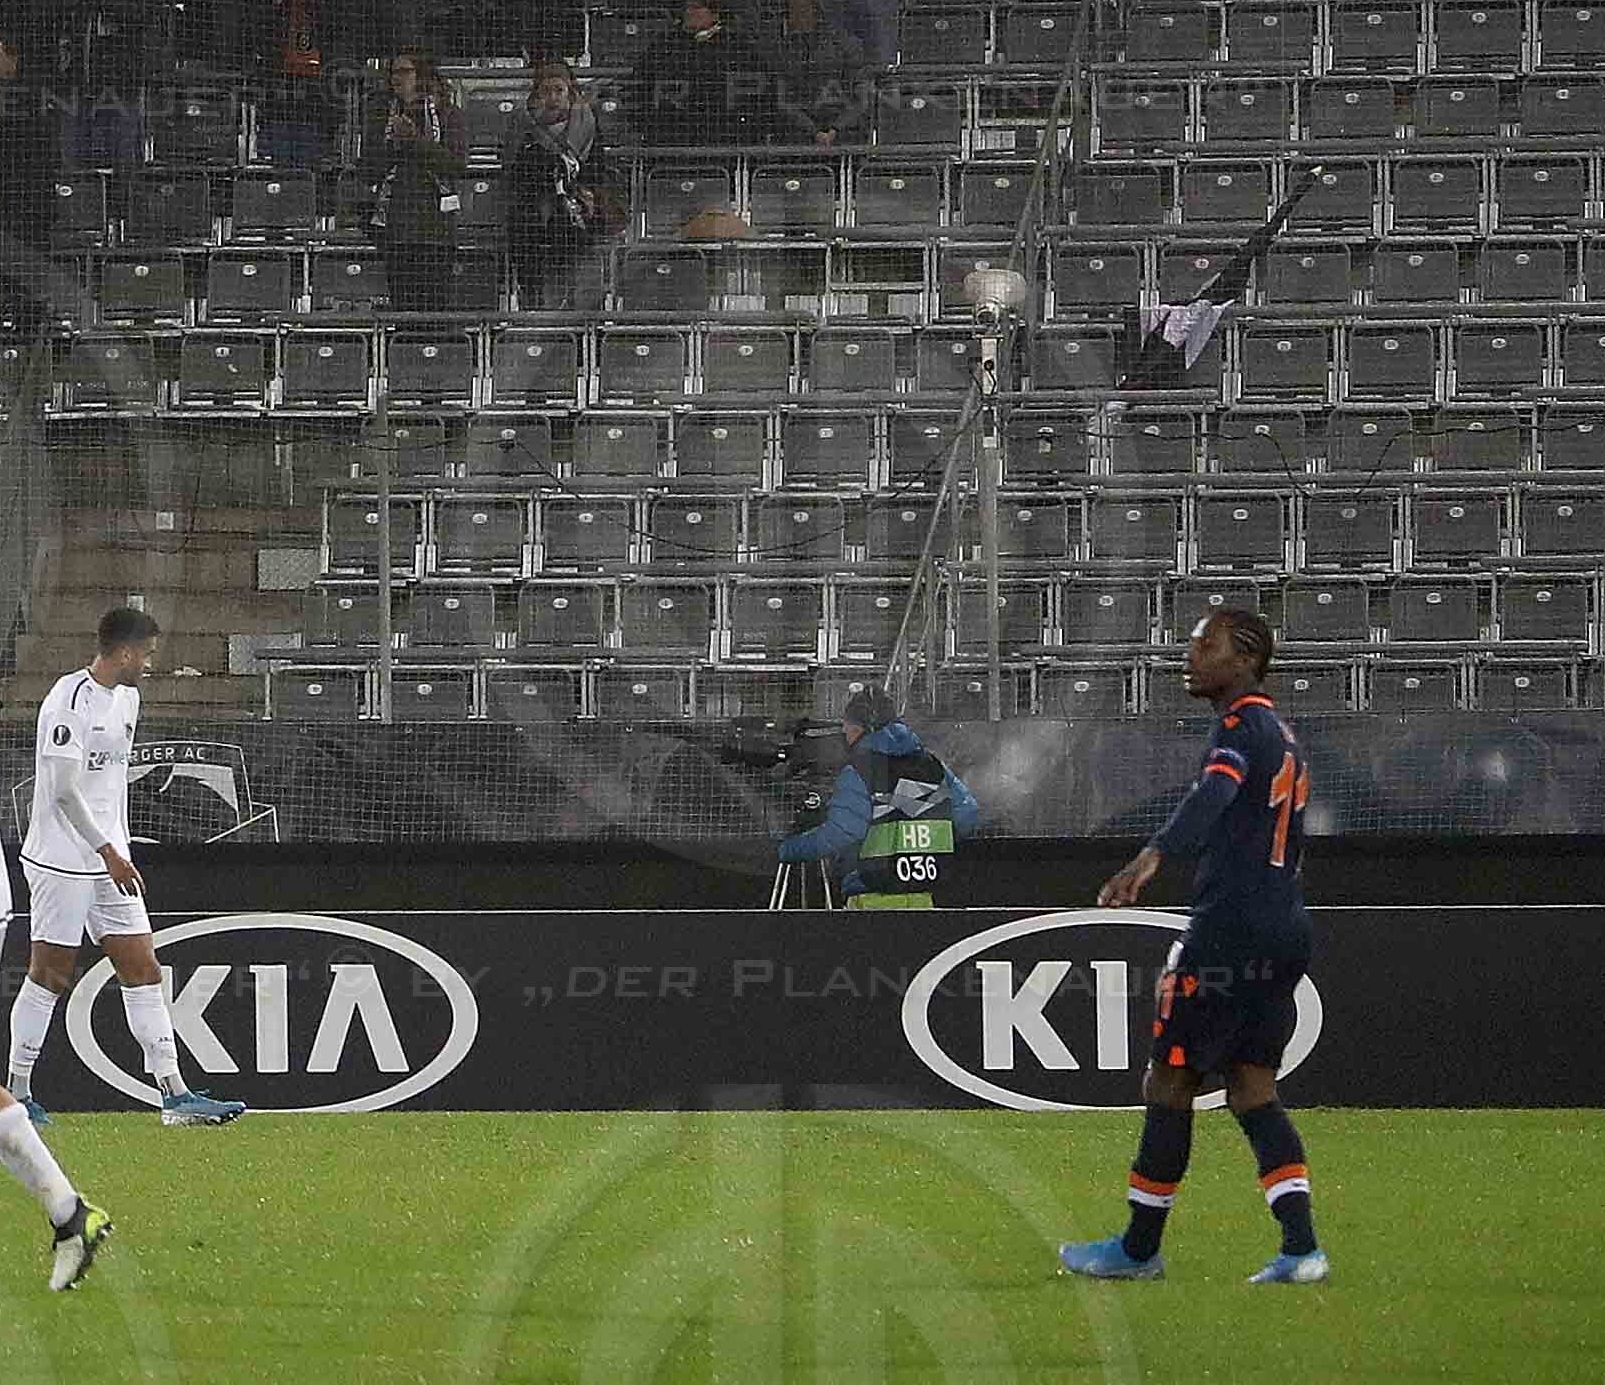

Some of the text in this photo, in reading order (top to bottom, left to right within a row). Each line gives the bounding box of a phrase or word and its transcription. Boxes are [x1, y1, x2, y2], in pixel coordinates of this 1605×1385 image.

[184, 746, 206, 761] AC
[902, 824, 931, 848] HB
[896, 855, 937, 882] 036
[161, 963, 411, 1075] KIA
[975, 960, 1133, 1072] KI
